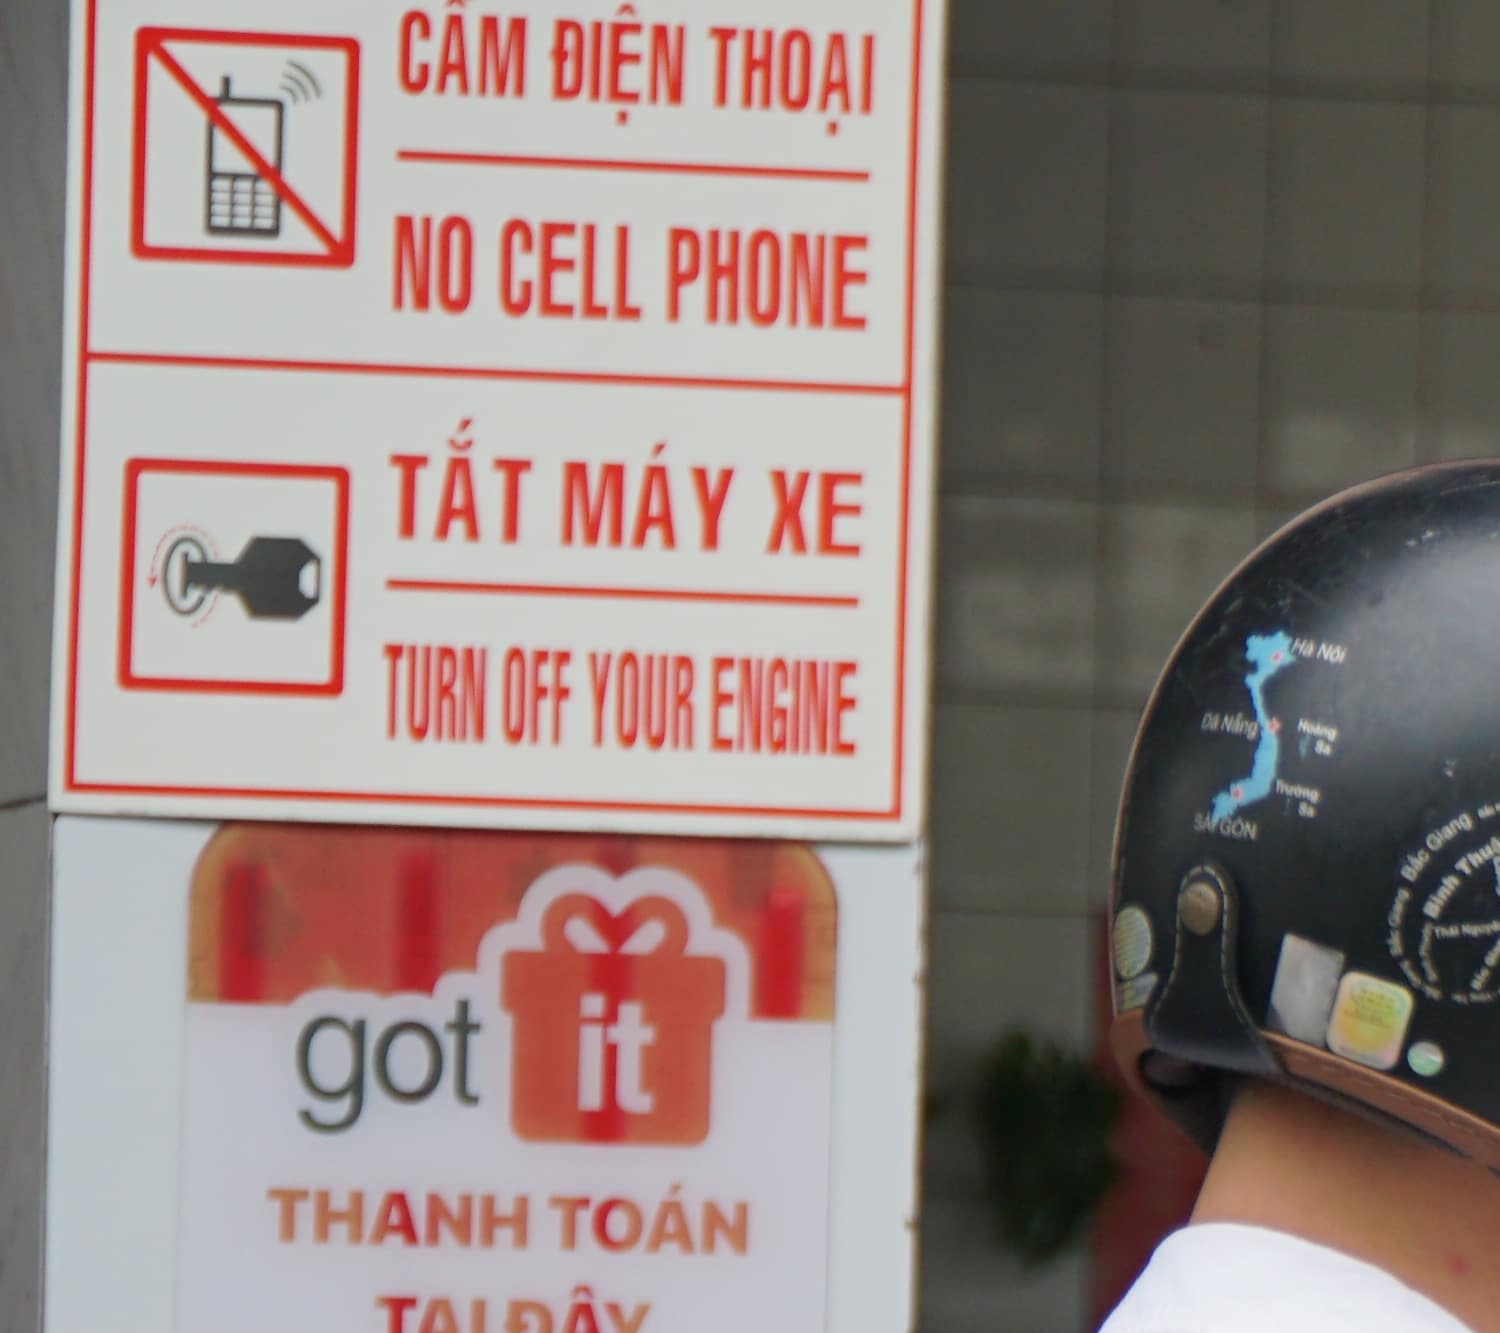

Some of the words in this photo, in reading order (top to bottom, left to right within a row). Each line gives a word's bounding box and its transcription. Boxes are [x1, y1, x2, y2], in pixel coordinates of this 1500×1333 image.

[550, 3, 685, 126] ĐIỆN
[709, 27, 874, 137] THOẠI
[392, 215, 473, 314] NO
[500, 219, 642, 322] CELL
[666, 225, 870, 331] PHONE
[390, 418, 533, 545] TẮT
[561, 444, 736, 552] MÁY
[765, 469, 864, 558] XE
[383, 642, 486, 744] TURN
[501, 647, 571, 748] OFF
[587, 651, 694, 752] YOUR
[709, 656, 858, 758] ENGINE
[295, 997, 483, 1135] got
[576, 992, 654, 1114] it
[269, 1187, 528, 1250] THANH
[548, 1184, 750, 1257] TOÁN
